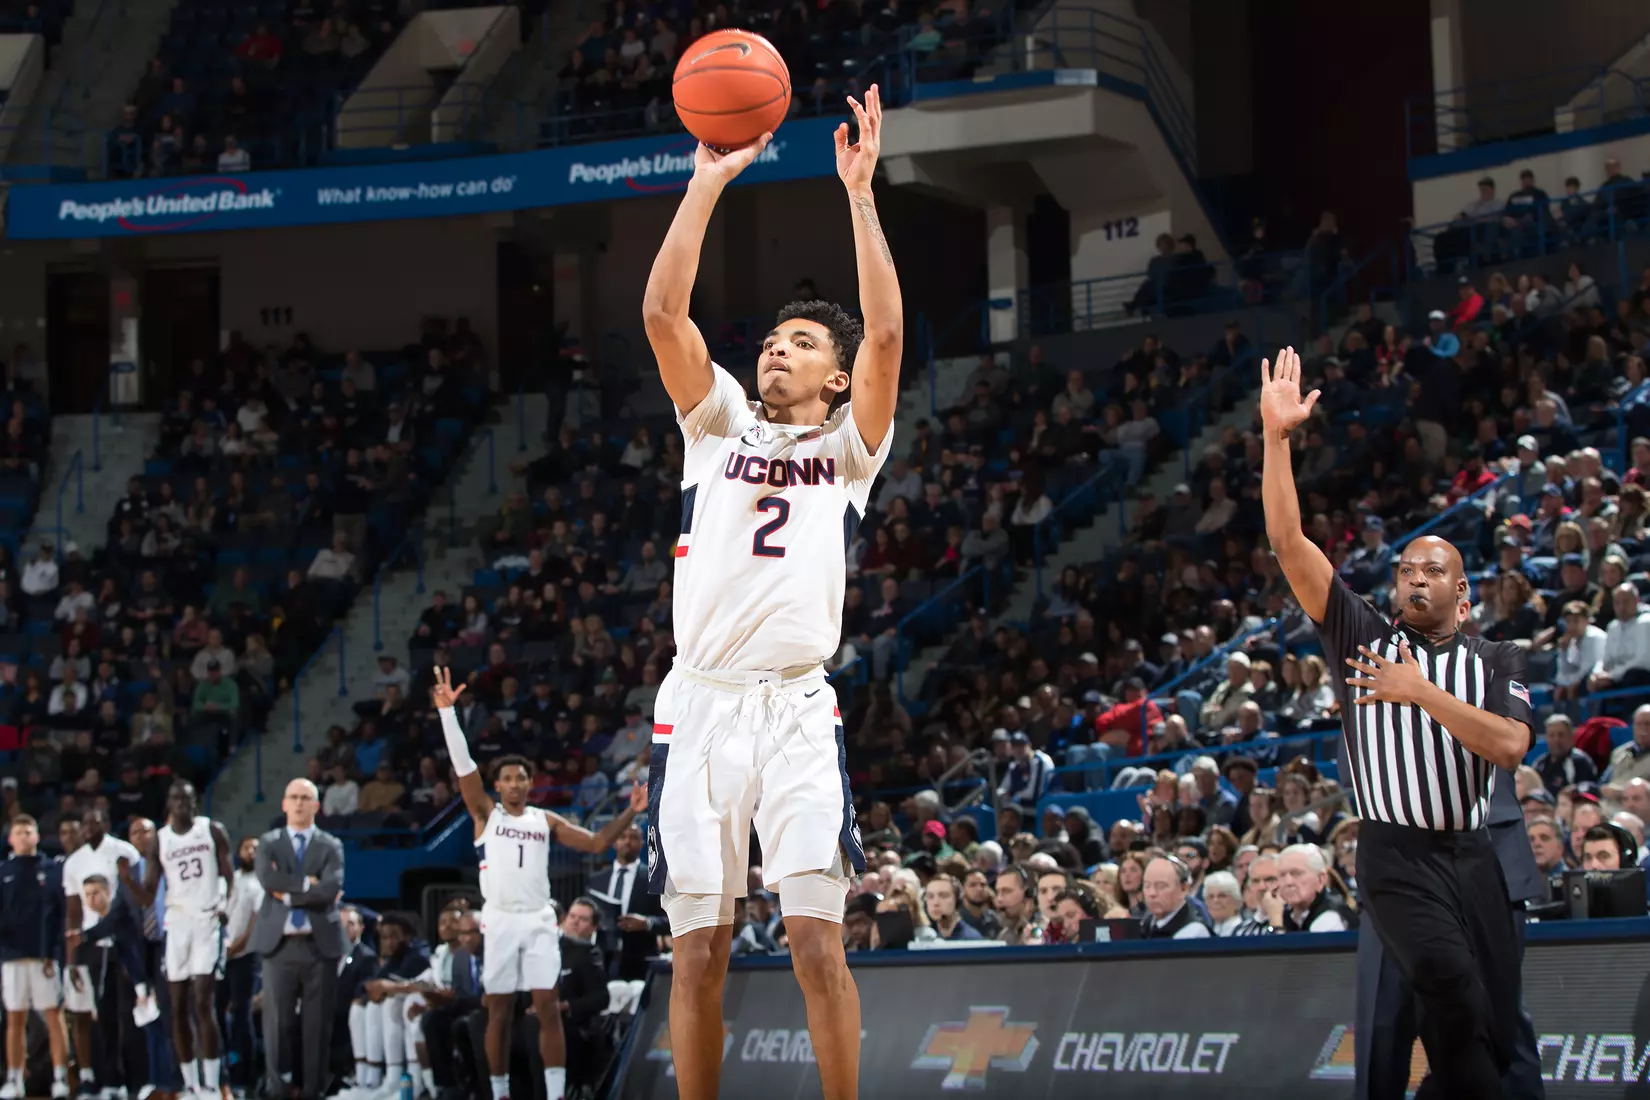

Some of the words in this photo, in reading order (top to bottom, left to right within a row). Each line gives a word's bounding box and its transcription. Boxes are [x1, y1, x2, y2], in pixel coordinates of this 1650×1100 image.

[653, 150, 695, 174] Unit
[146, 192, 217, 215] United
[218, 188, 274, 210] Bank
[317, 186, 361, 205] What
[366, 182, 453, 202] know-how
[456, 179, 487, 196] can
[1104, 217, 1140, 241] 112
[259, 306, 293, 327] 111
[725, 452, 835, 488] UCONN
[752, 496, 790, 558] 2
[495, 825, 546, 843] UCONN
[178, 858, 203, 880] 23
[518, 844, 524, 868] 1
[741, 1029, 868, 1062] CHEVR
[1053, 1032, 1240, 1073] CHEVROLET
[1537, 1034, 1650, 1082] CHEV
